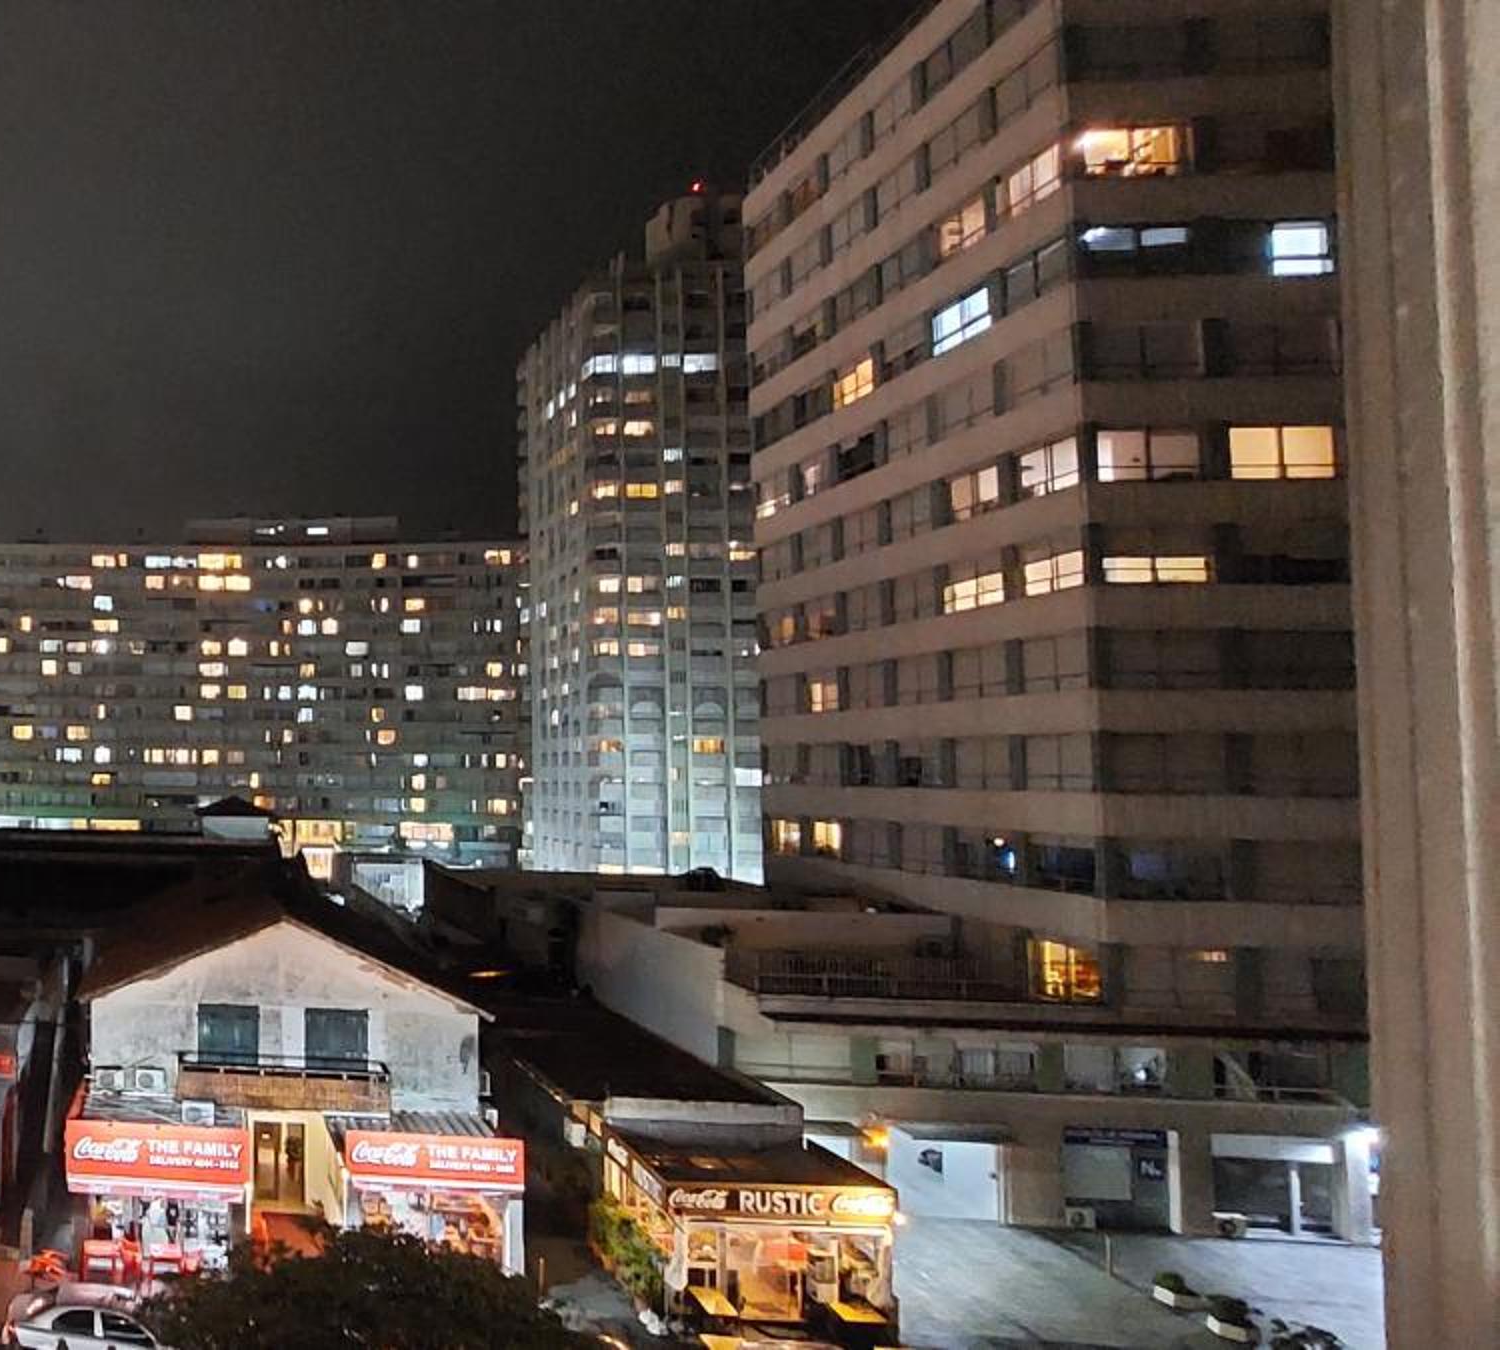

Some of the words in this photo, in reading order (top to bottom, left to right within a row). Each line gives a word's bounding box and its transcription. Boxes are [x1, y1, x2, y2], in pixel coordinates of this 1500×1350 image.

[148, 1138, 179, 1155] THE
[182, 1141, 243, 1160] FAMILY
[427, 1144, 459, 1159] THE
[461, 1146, 517, 1164] FAMILY
[668, 1187, 729, 1211] Coca-Cola
[739, 1191, 824, 1215] RUSTIC
